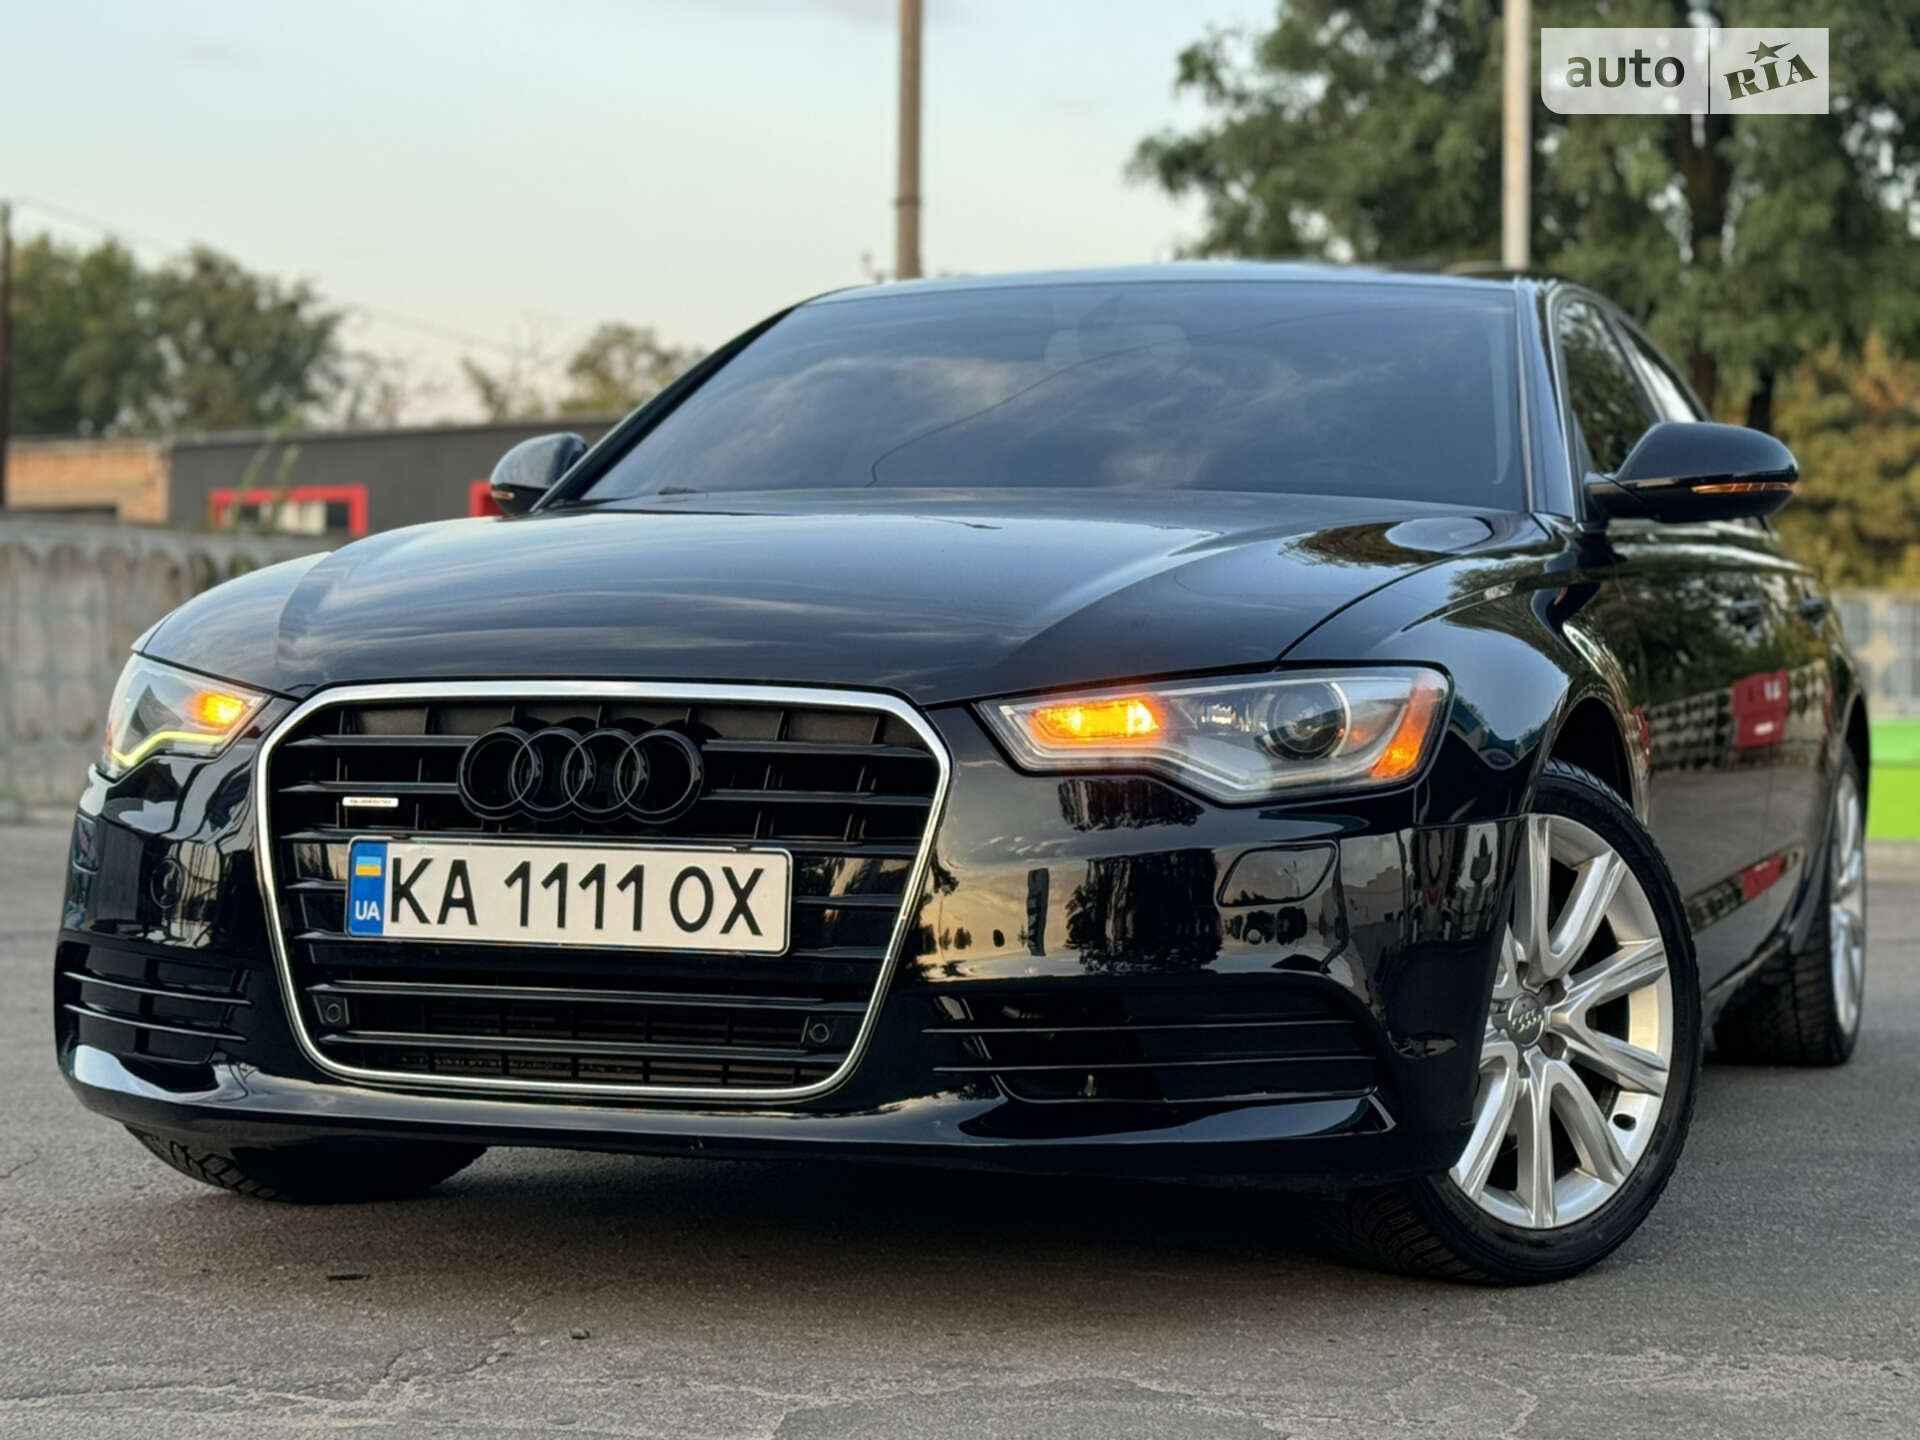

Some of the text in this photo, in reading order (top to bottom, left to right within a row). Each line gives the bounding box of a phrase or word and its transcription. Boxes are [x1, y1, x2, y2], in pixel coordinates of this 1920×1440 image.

[354, 901, 380, 921] UA
[390, 857, 764, 936] KA 1111 OX
